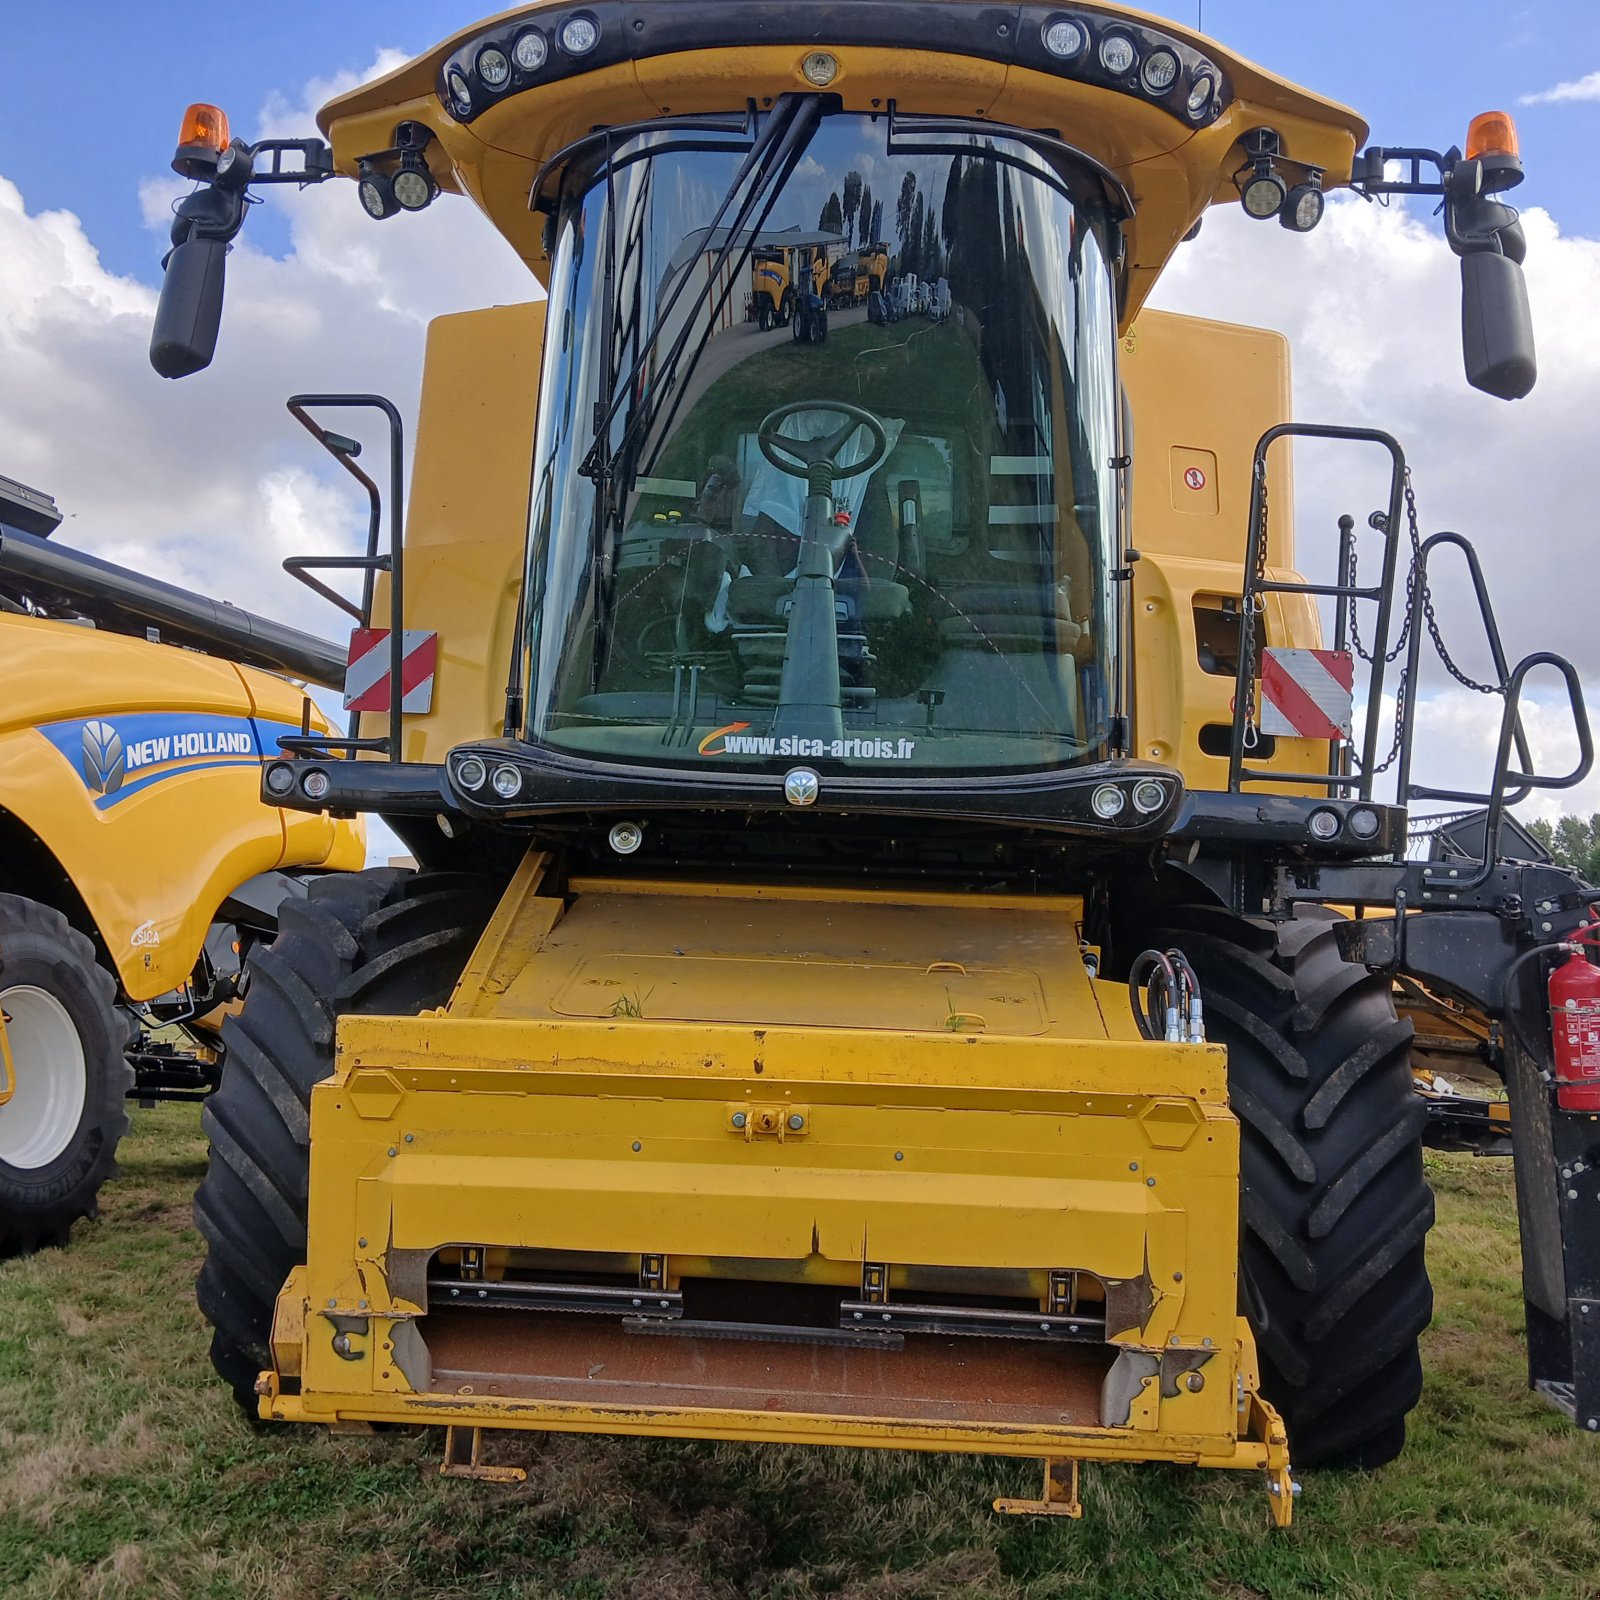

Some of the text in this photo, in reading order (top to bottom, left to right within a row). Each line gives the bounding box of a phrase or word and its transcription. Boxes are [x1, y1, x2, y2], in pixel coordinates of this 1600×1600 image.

[126, 732, 251, 768] NEW HOLLAND
[724, 735, 915, 759] www.sica-artois.fr
[137, 931, 160, 944] SICA
